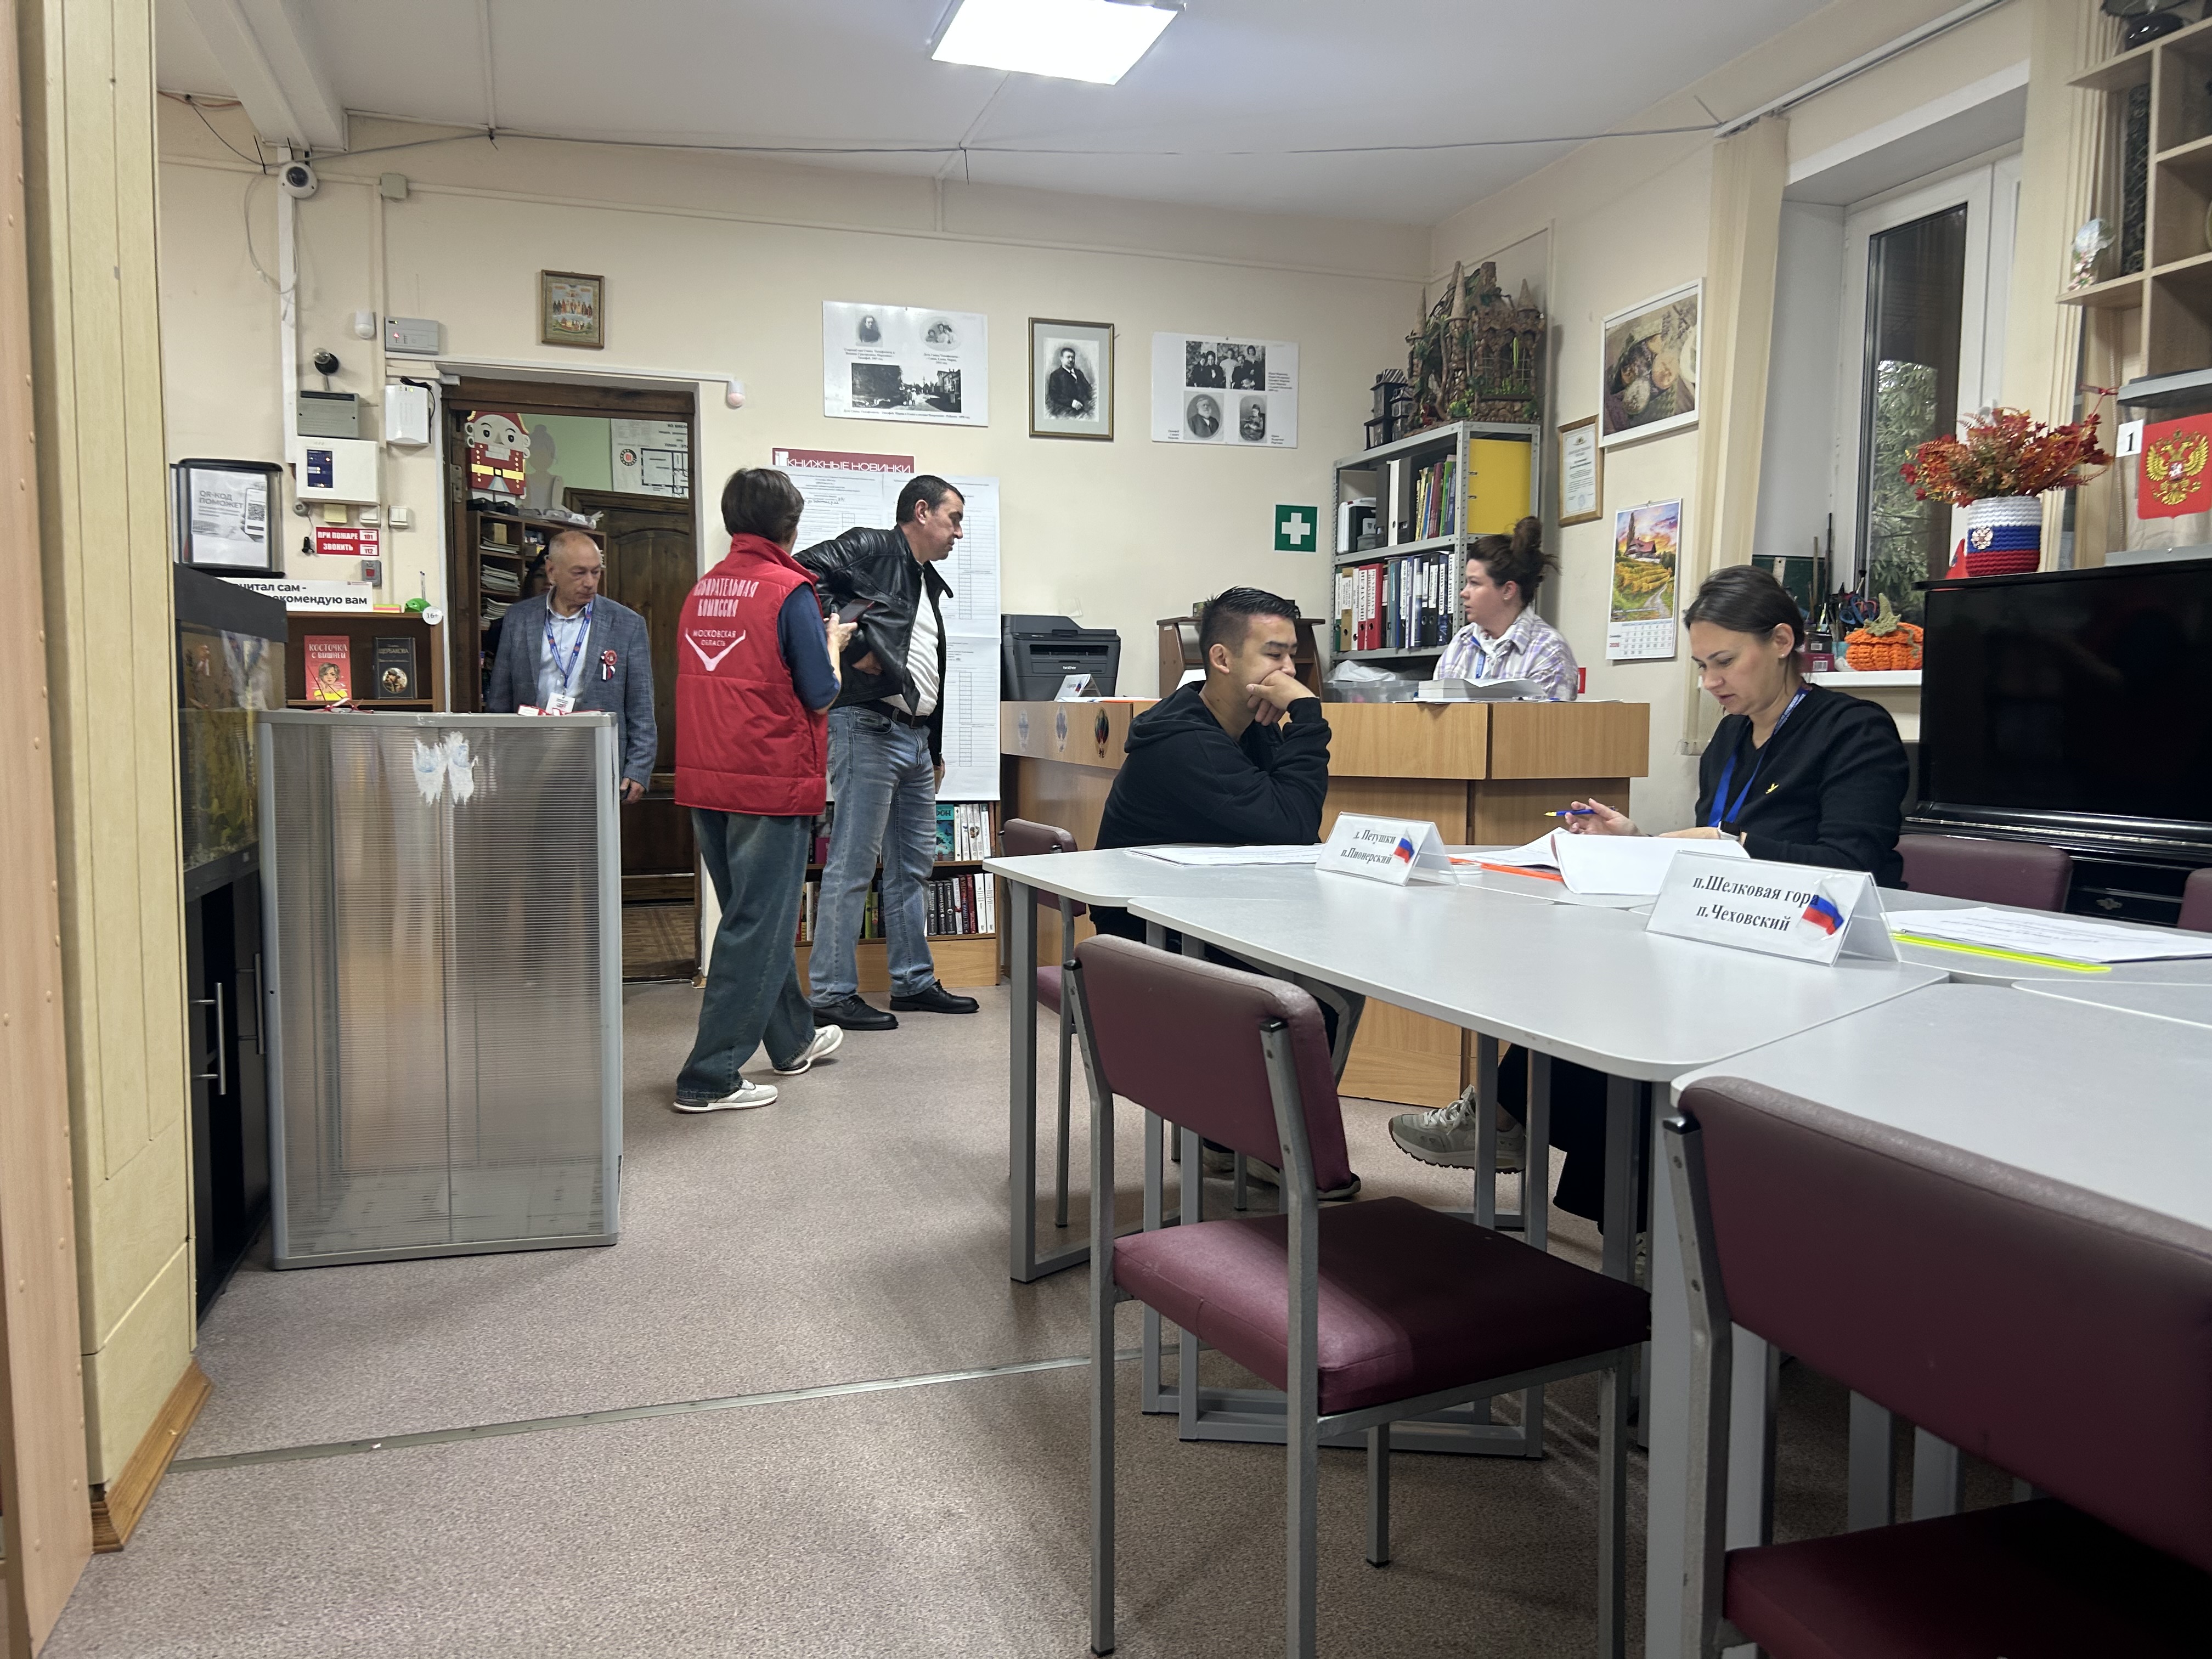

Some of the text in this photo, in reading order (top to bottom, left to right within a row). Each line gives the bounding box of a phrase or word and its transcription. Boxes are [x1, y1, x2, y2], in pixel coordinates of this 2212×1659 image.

[2126, 431, 2135, 452] 1
[787, 459, 911, 473] КНИЖНЫЕ НОВИНКИ
[199, 490, 233, 501] QR-КОД
[199, 498, 244, 508] ПОМОЖЕТ
[331, 532, 358, 540] ПОЖАРЕ
[697, 599, 739, 617] КОМИССИЯ
[692, 629, 736, 638] МОСКОВСКАЯ
[1361, 830, 1396, 844] Петушки
[1340, 848, 1393, 864] п.Пионерский
[1692, 875, 1819, 908] п.Шелковая гора
[1696, 904, 1791, 932] п.Чеховский
